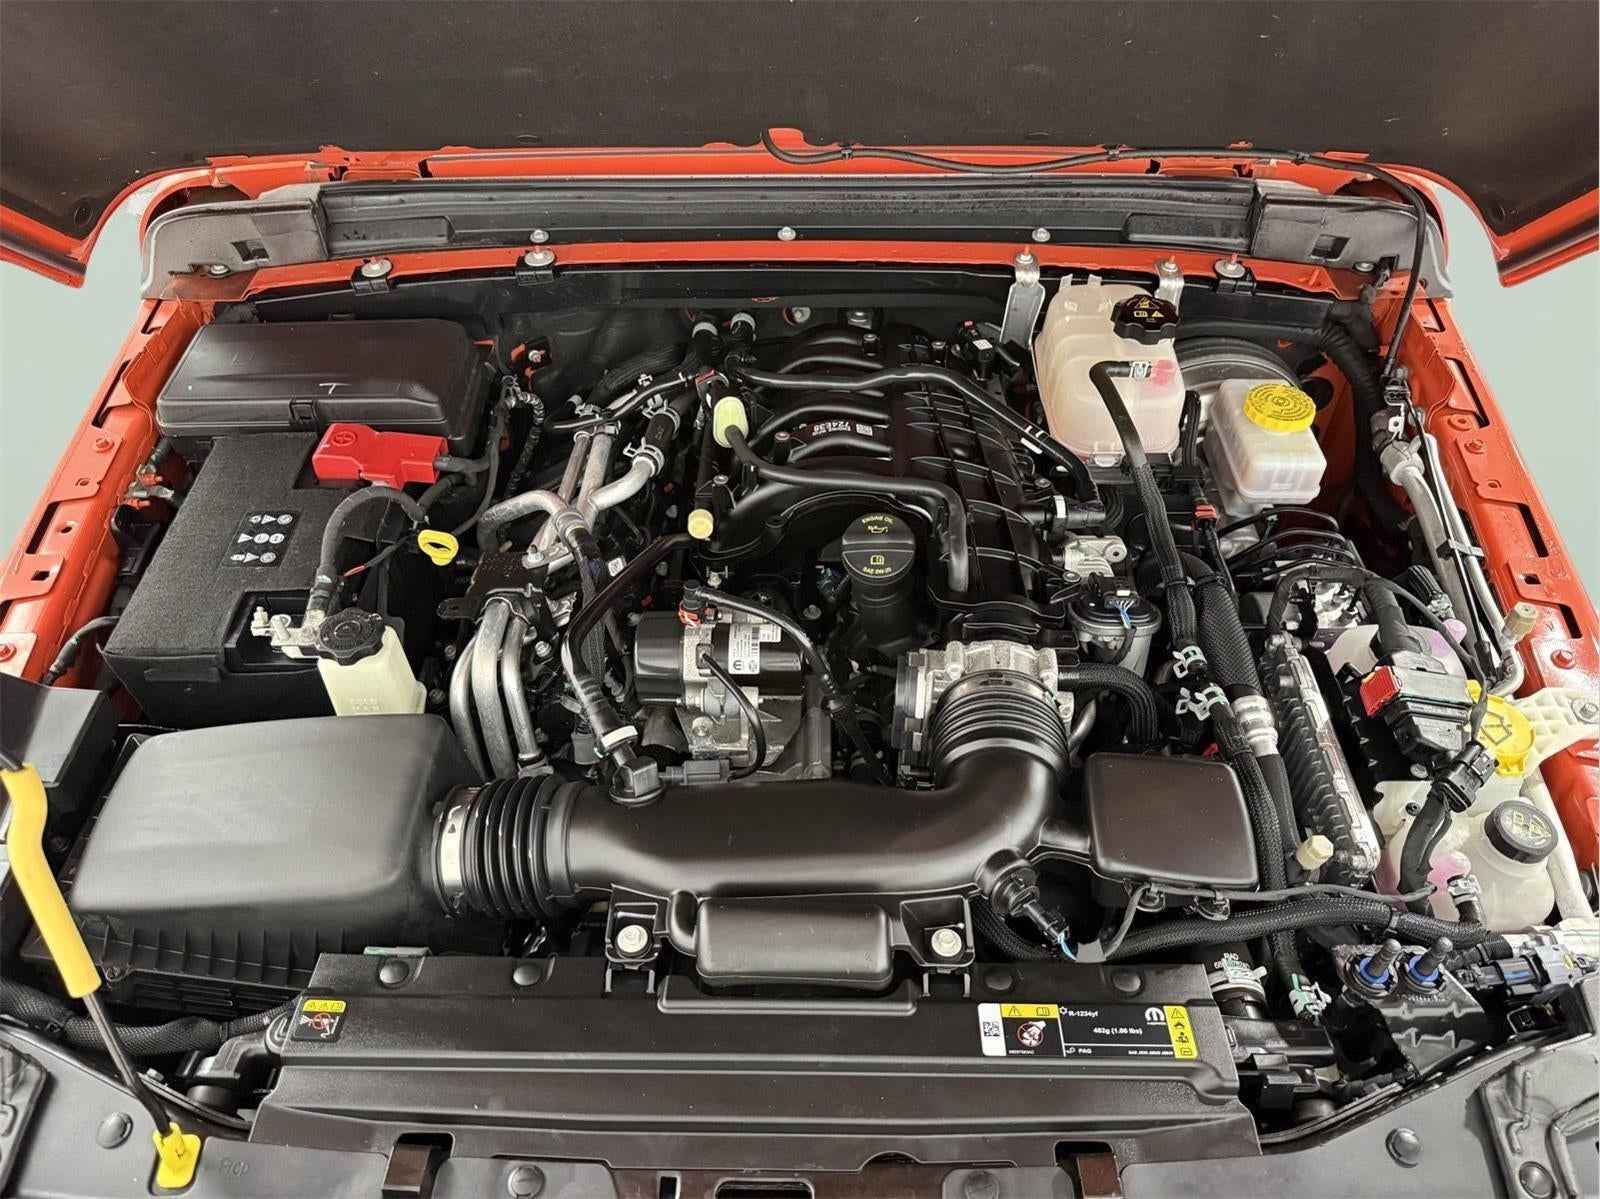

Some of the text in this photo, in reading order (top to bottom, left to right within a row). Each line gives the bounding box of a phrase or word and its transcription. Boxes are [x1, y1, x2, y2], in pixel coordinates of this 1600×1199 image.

[861, 516, 893, 525] ENGINE OIL
[862, 566, 874, 574] SAE
[1068, 1010, 1099, 1018] R-1234yf
